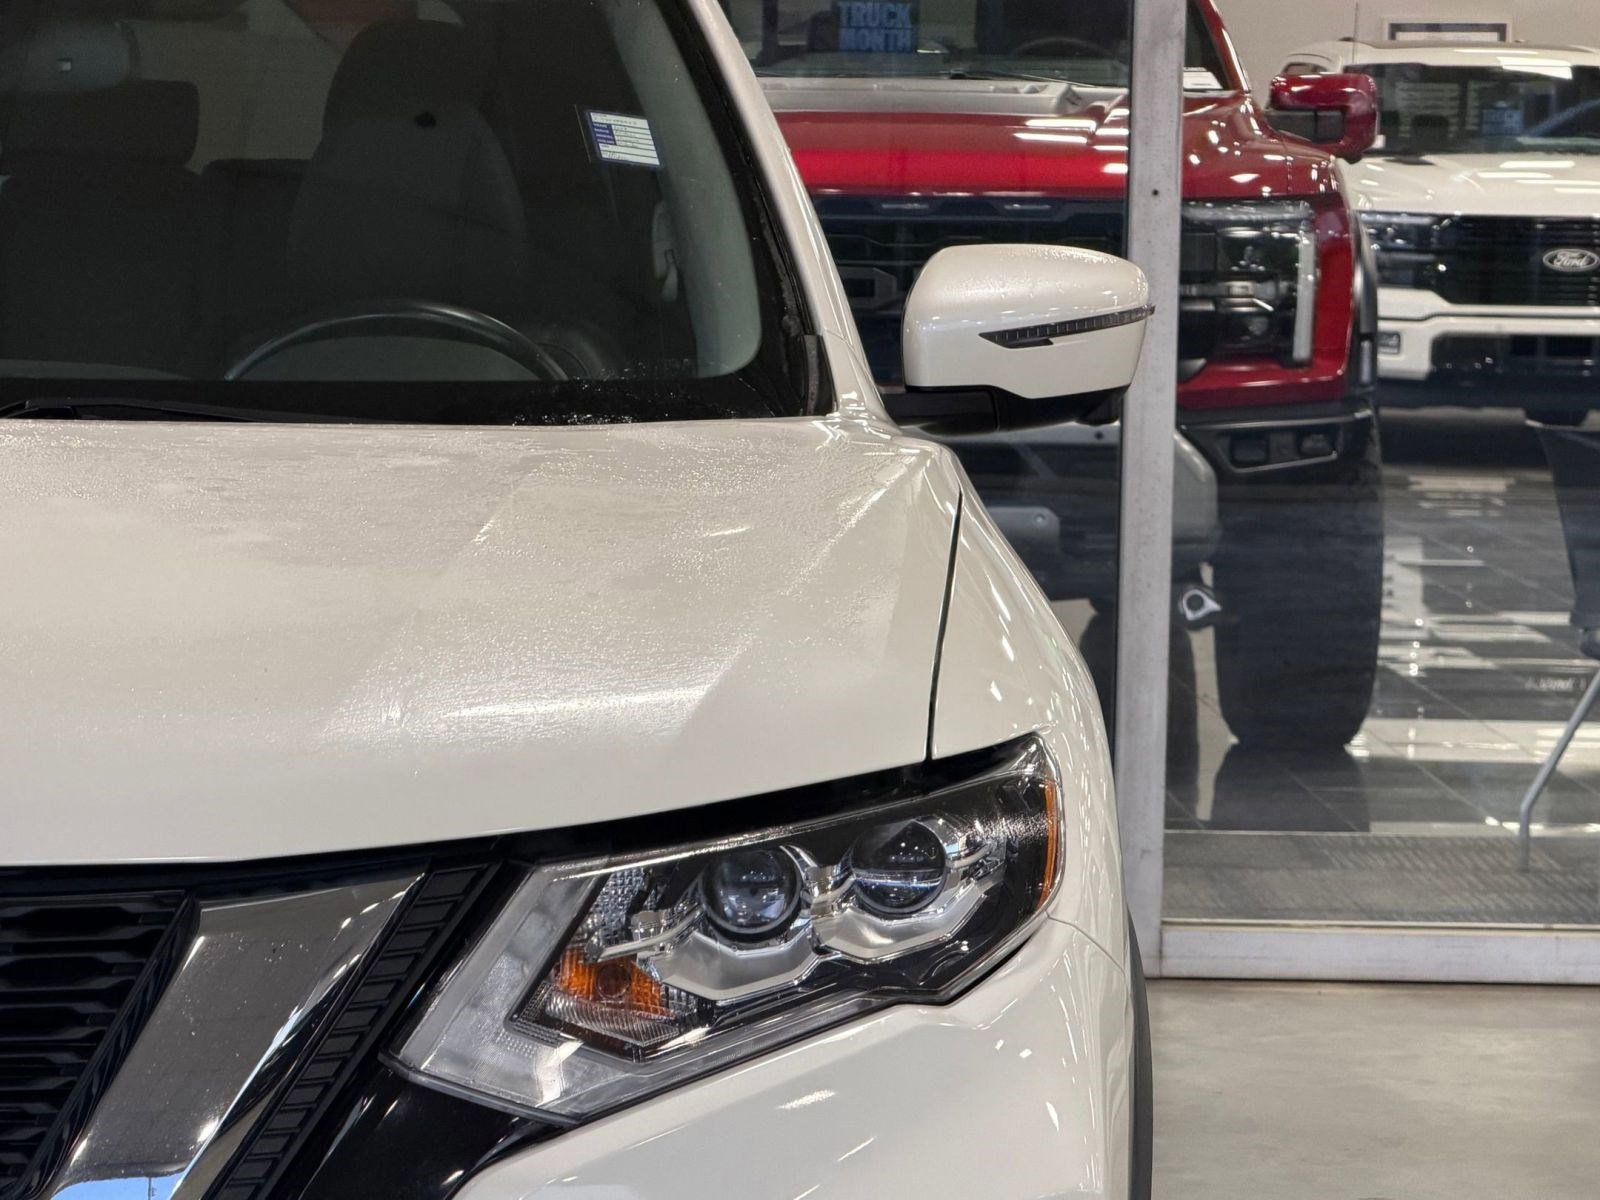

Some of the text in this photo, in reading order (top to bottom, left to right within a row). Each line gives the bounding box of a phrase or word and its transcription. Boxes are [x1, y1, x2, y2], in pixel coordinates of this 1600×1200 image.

[838, 1, 913, 27] TRUCK
[839, 28, 913, 52] MONTH
[1551, 251, 1590, 268] Ford
